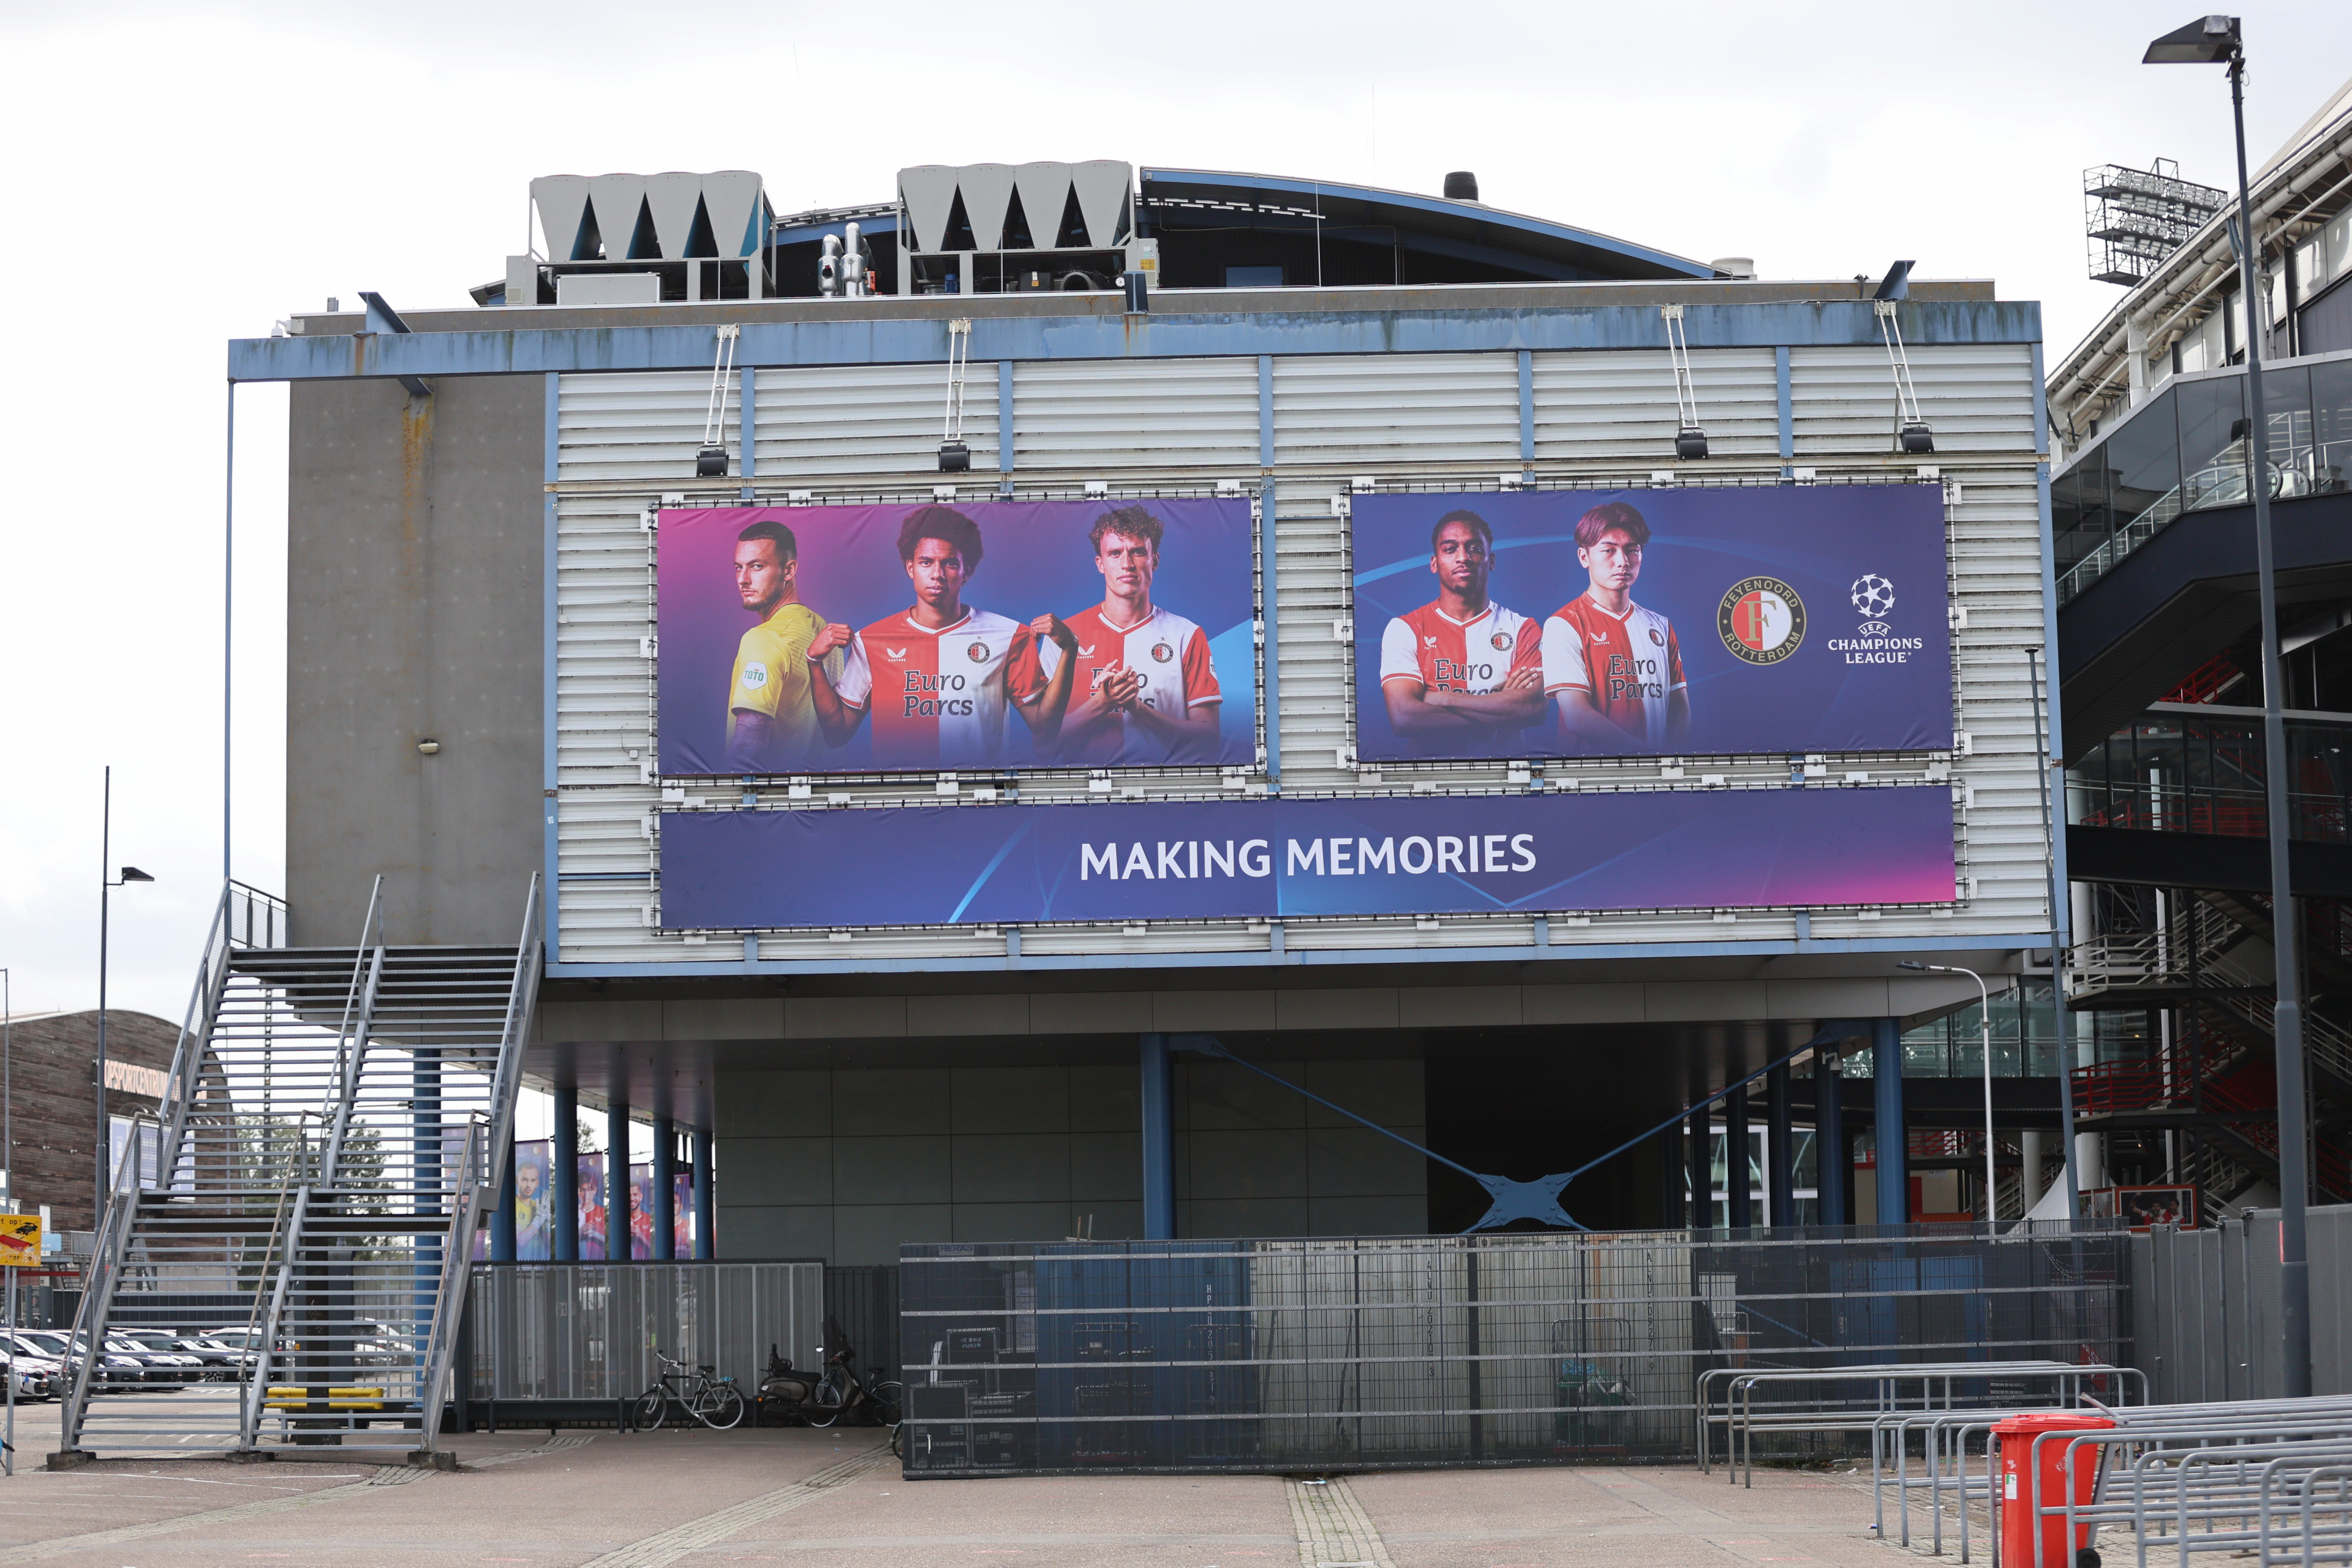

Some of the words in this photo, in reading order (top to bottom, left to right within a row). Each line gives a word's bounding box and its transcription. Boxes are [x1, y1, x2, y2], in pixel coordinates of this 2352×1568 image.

[1724, 579, 1798, 609] FEYENOORD
[1743, 600, 1777, 641] F
[1859, 624, 1888, 635] UEFA
[1725, 631, 1800, 662] ROTTERDAM
[1828, 638, 1923, 650] CHAMPIONS
[744, 670, 764, 681] TOTO
[1434, 658, 1493, 680] Euro
[1609, 654, 1656, 676] Euro
[904, 669, 966, 692] Euro
[1610, 678, 1663, 700] Parcs
[903, 695, 973, 717] Parcs
[1080, 839, 1271, 880] MAKING
[1287, 833, 1536, 876] MEMORIES
